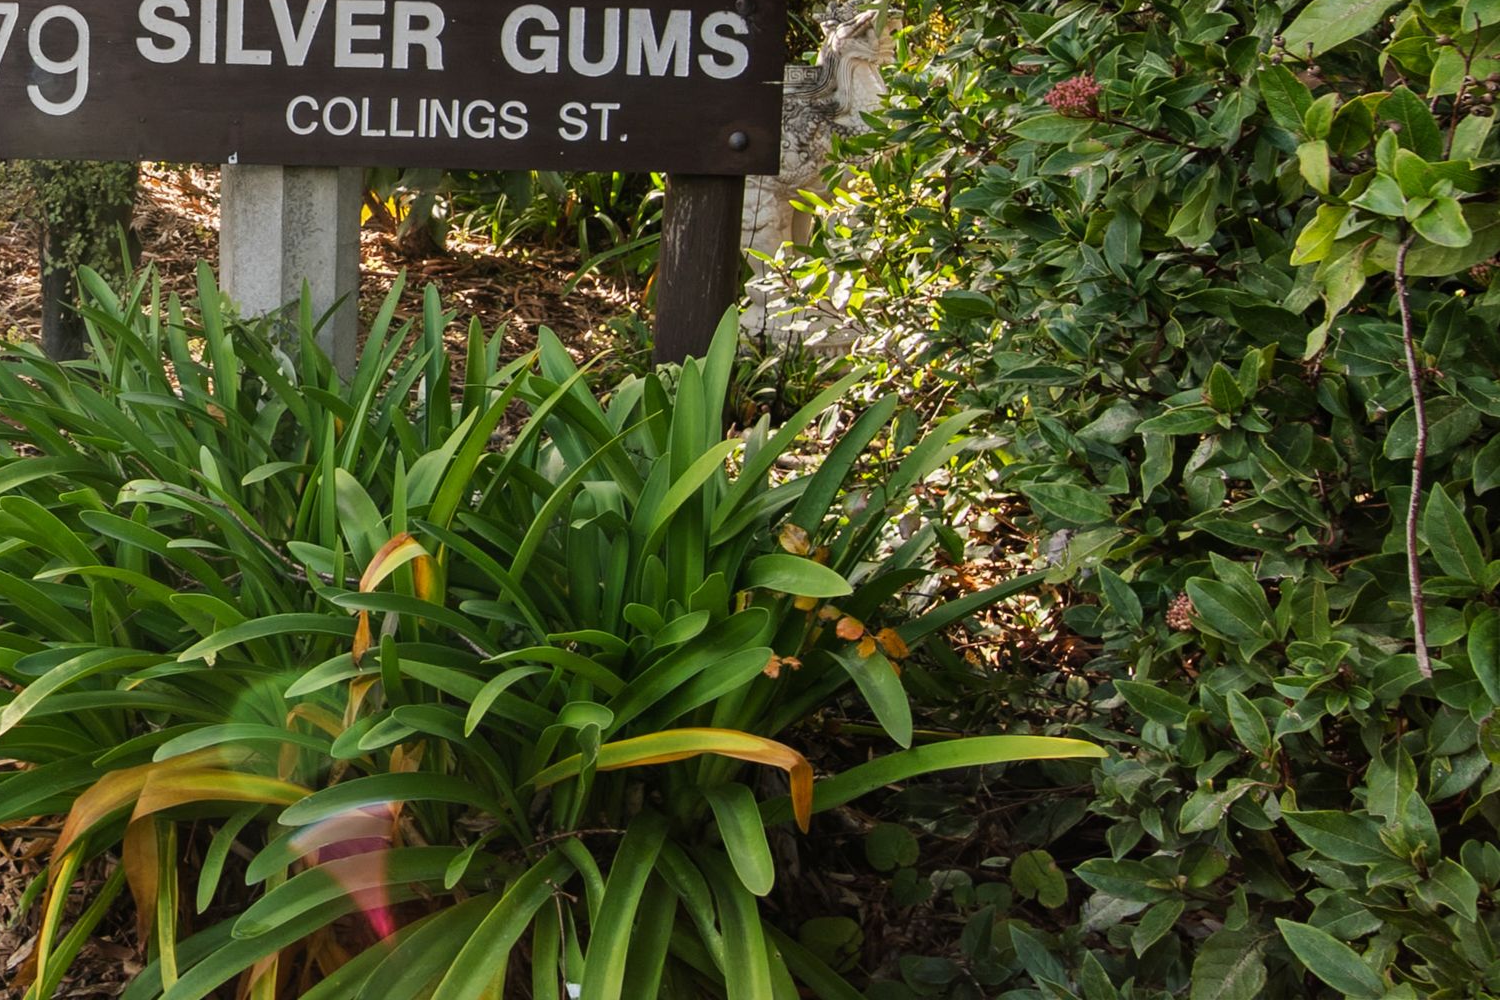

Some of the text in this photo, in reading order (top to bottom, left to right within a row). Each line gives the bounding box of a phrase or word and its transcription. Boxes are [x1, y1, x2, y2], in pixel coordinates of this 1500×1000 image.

[501, 3, 750, 80] GUMS
[285, 95, 629, 143] COLLINGS ST.
